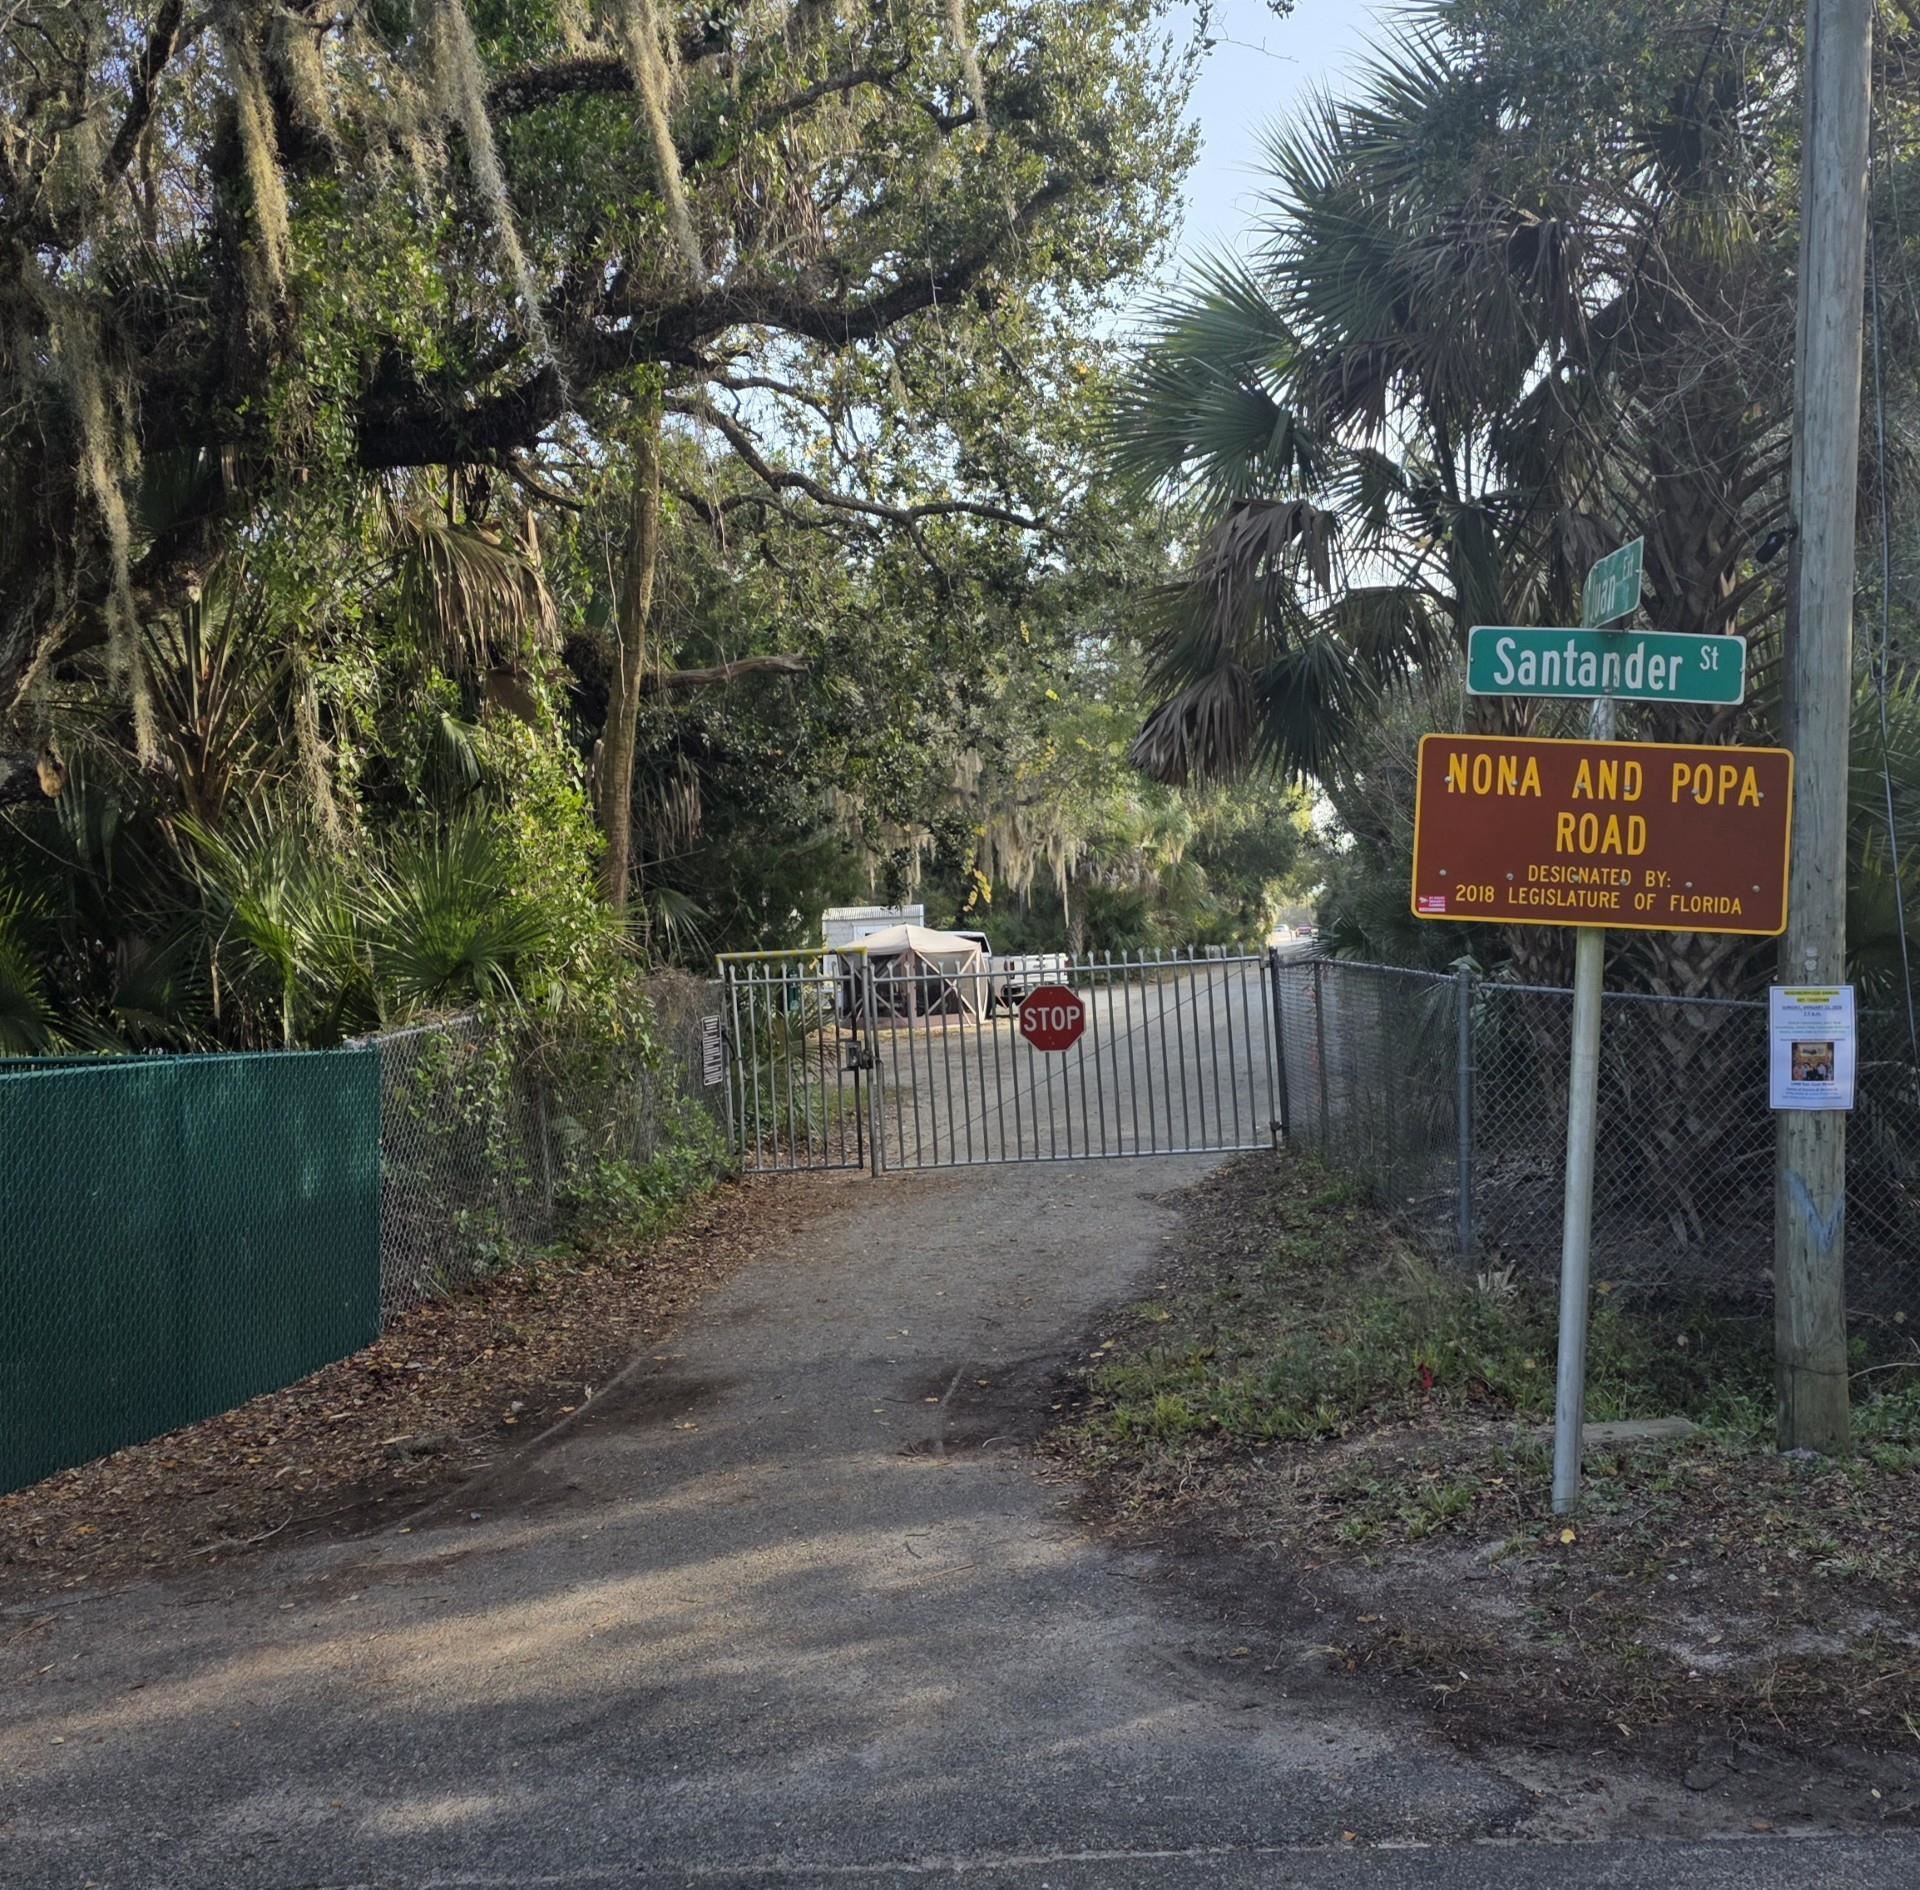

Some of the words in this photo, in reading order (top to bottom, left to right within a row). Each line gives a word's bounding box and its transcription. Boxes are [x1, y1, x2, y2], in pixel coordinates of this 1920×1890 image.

[1493, 636, 1683, 692] Santander
[1700, 645, 1720, 671] St
[1448, 753, 1542, 797] NONA
[1571, 759, 1643, 802] AND
[1671, 763, 1760, 807] POPA
[1556, 812, 1647, 856] ROAD
[1528, 865, 1632, 886] DESIGNATED
[1645, 870, 1671, 888] BY:
[1455, 884, 1495, 903] 2018
[1508, 887, 1621, 909] LEGISLATURE
[1634, 892, 1656, 911] OF
[1670, 895, 1742, 915] FLORIDA
[1023, 1005, 1081, 1032] STOP
